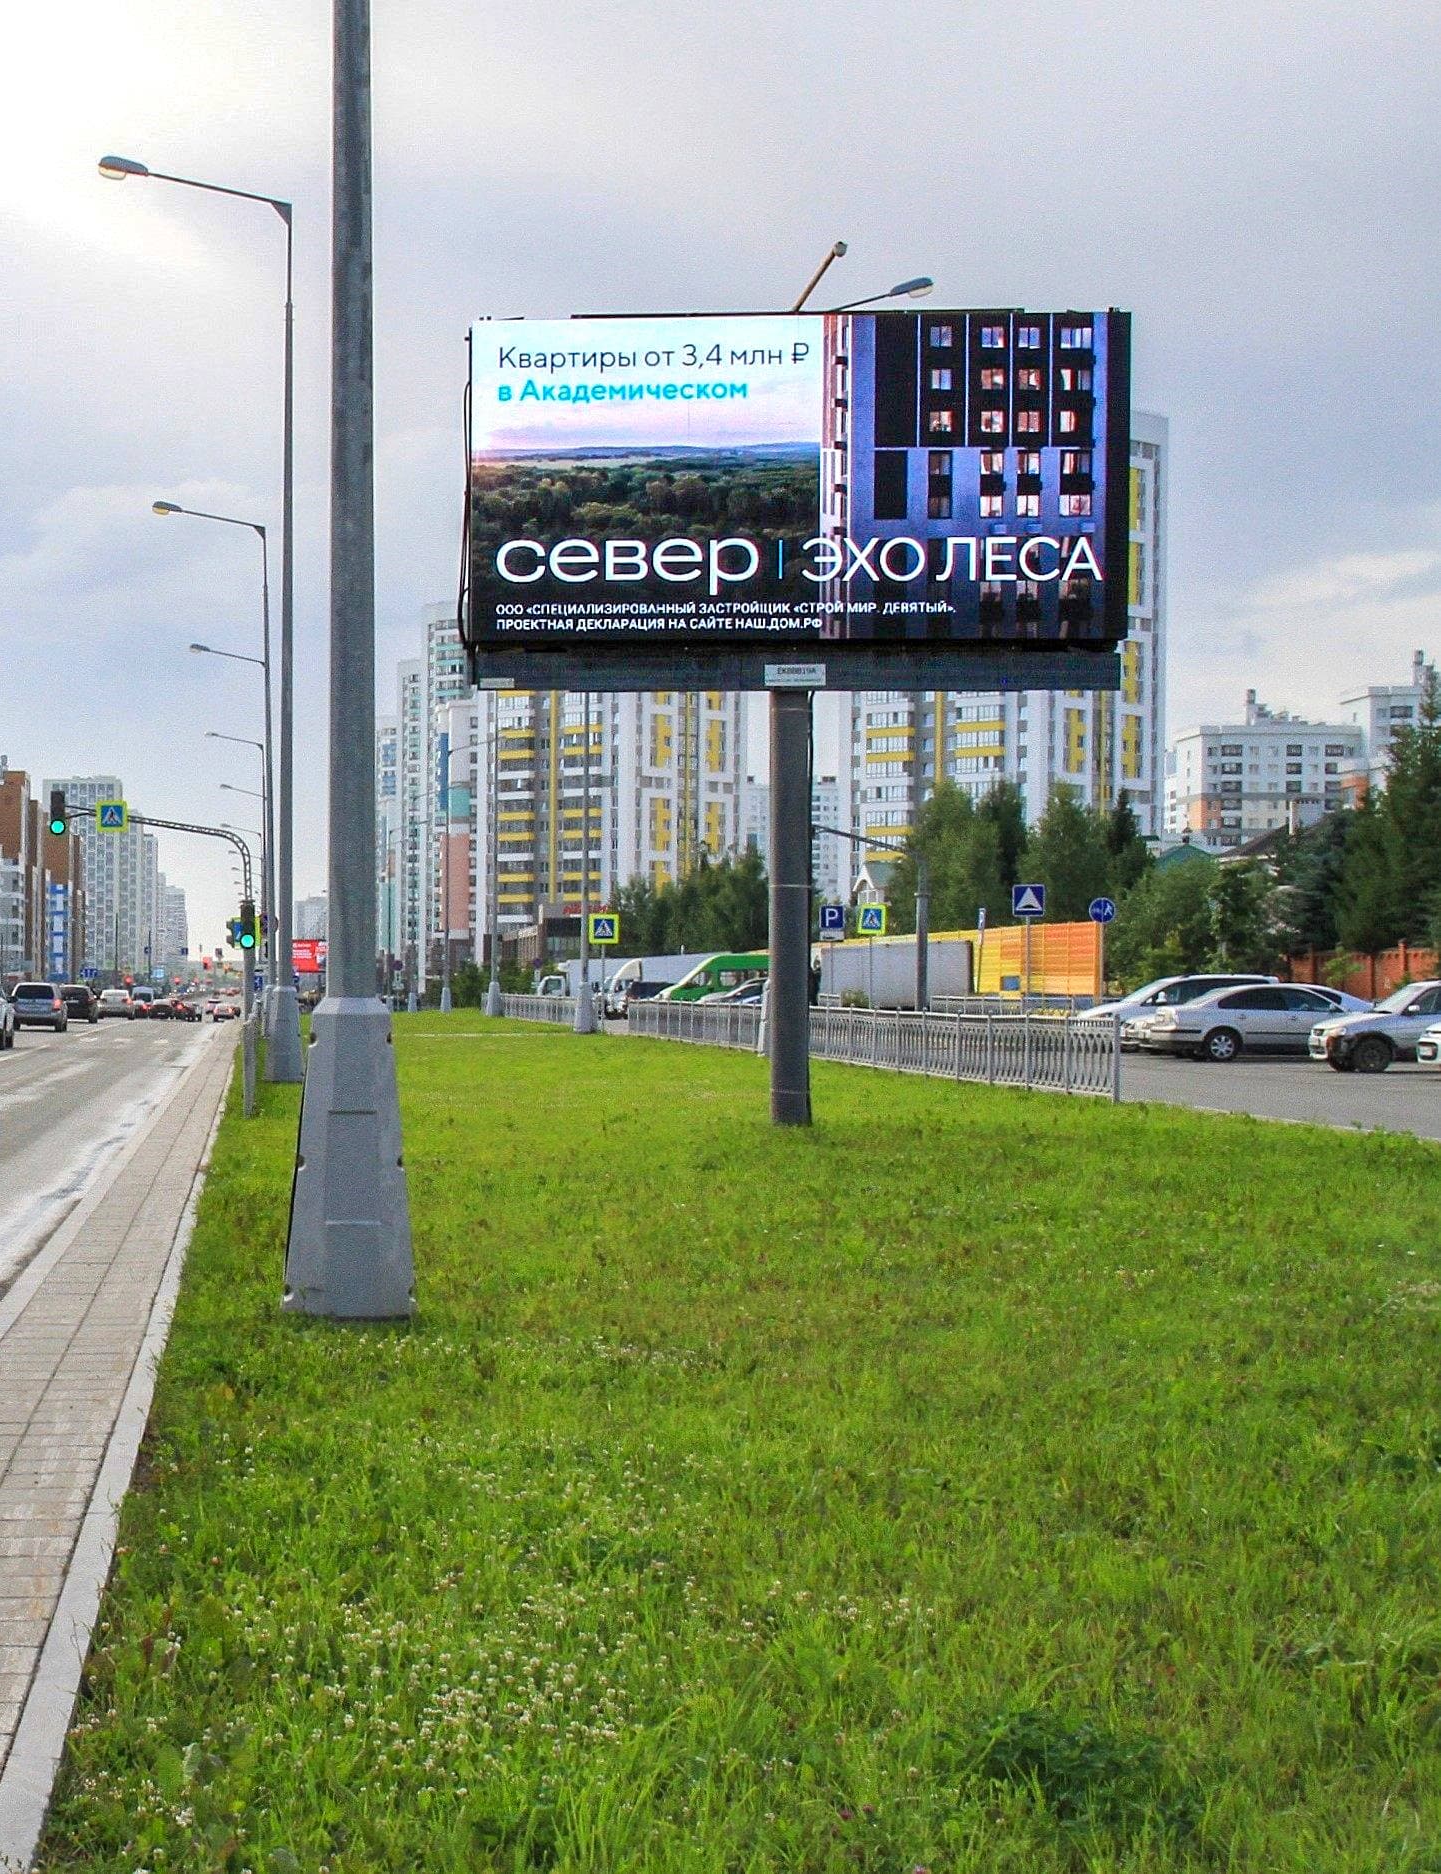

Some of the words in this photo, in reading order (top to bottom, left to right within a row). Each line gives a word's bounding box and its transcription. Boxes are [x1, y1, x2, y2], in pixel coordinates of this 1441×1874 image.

[498, 346, 636, 373] Квартиры
[644, 350, 675, 366] от
[681, 343, 722, 369] 3,4
[730, 347, 783, 366] млн
[498, 385, 513, 401] в
[519, 379, 748, 404] Академическом
[496, 537, 759, 596] север
[801, 536, 926, 582] ЭХО
[936, 536, 1103, 582] ЛЕСА
[495, 604, 524, 615] ООО
[698, 601, 791, 615] ЗАСТРОЙЩИК
[496, 619, 574, 631] ПРОЕКТНАЯ
[576, 618, 666, 632] ДЕКЛАРАЦИЯ
[668, 618, 687, 630] НА
[689, 617, 733, 630] САЙТЕ
[735, 617, 823, 631] НАШ.ДОМ.РФ
[825, 908, 839, 927] P
